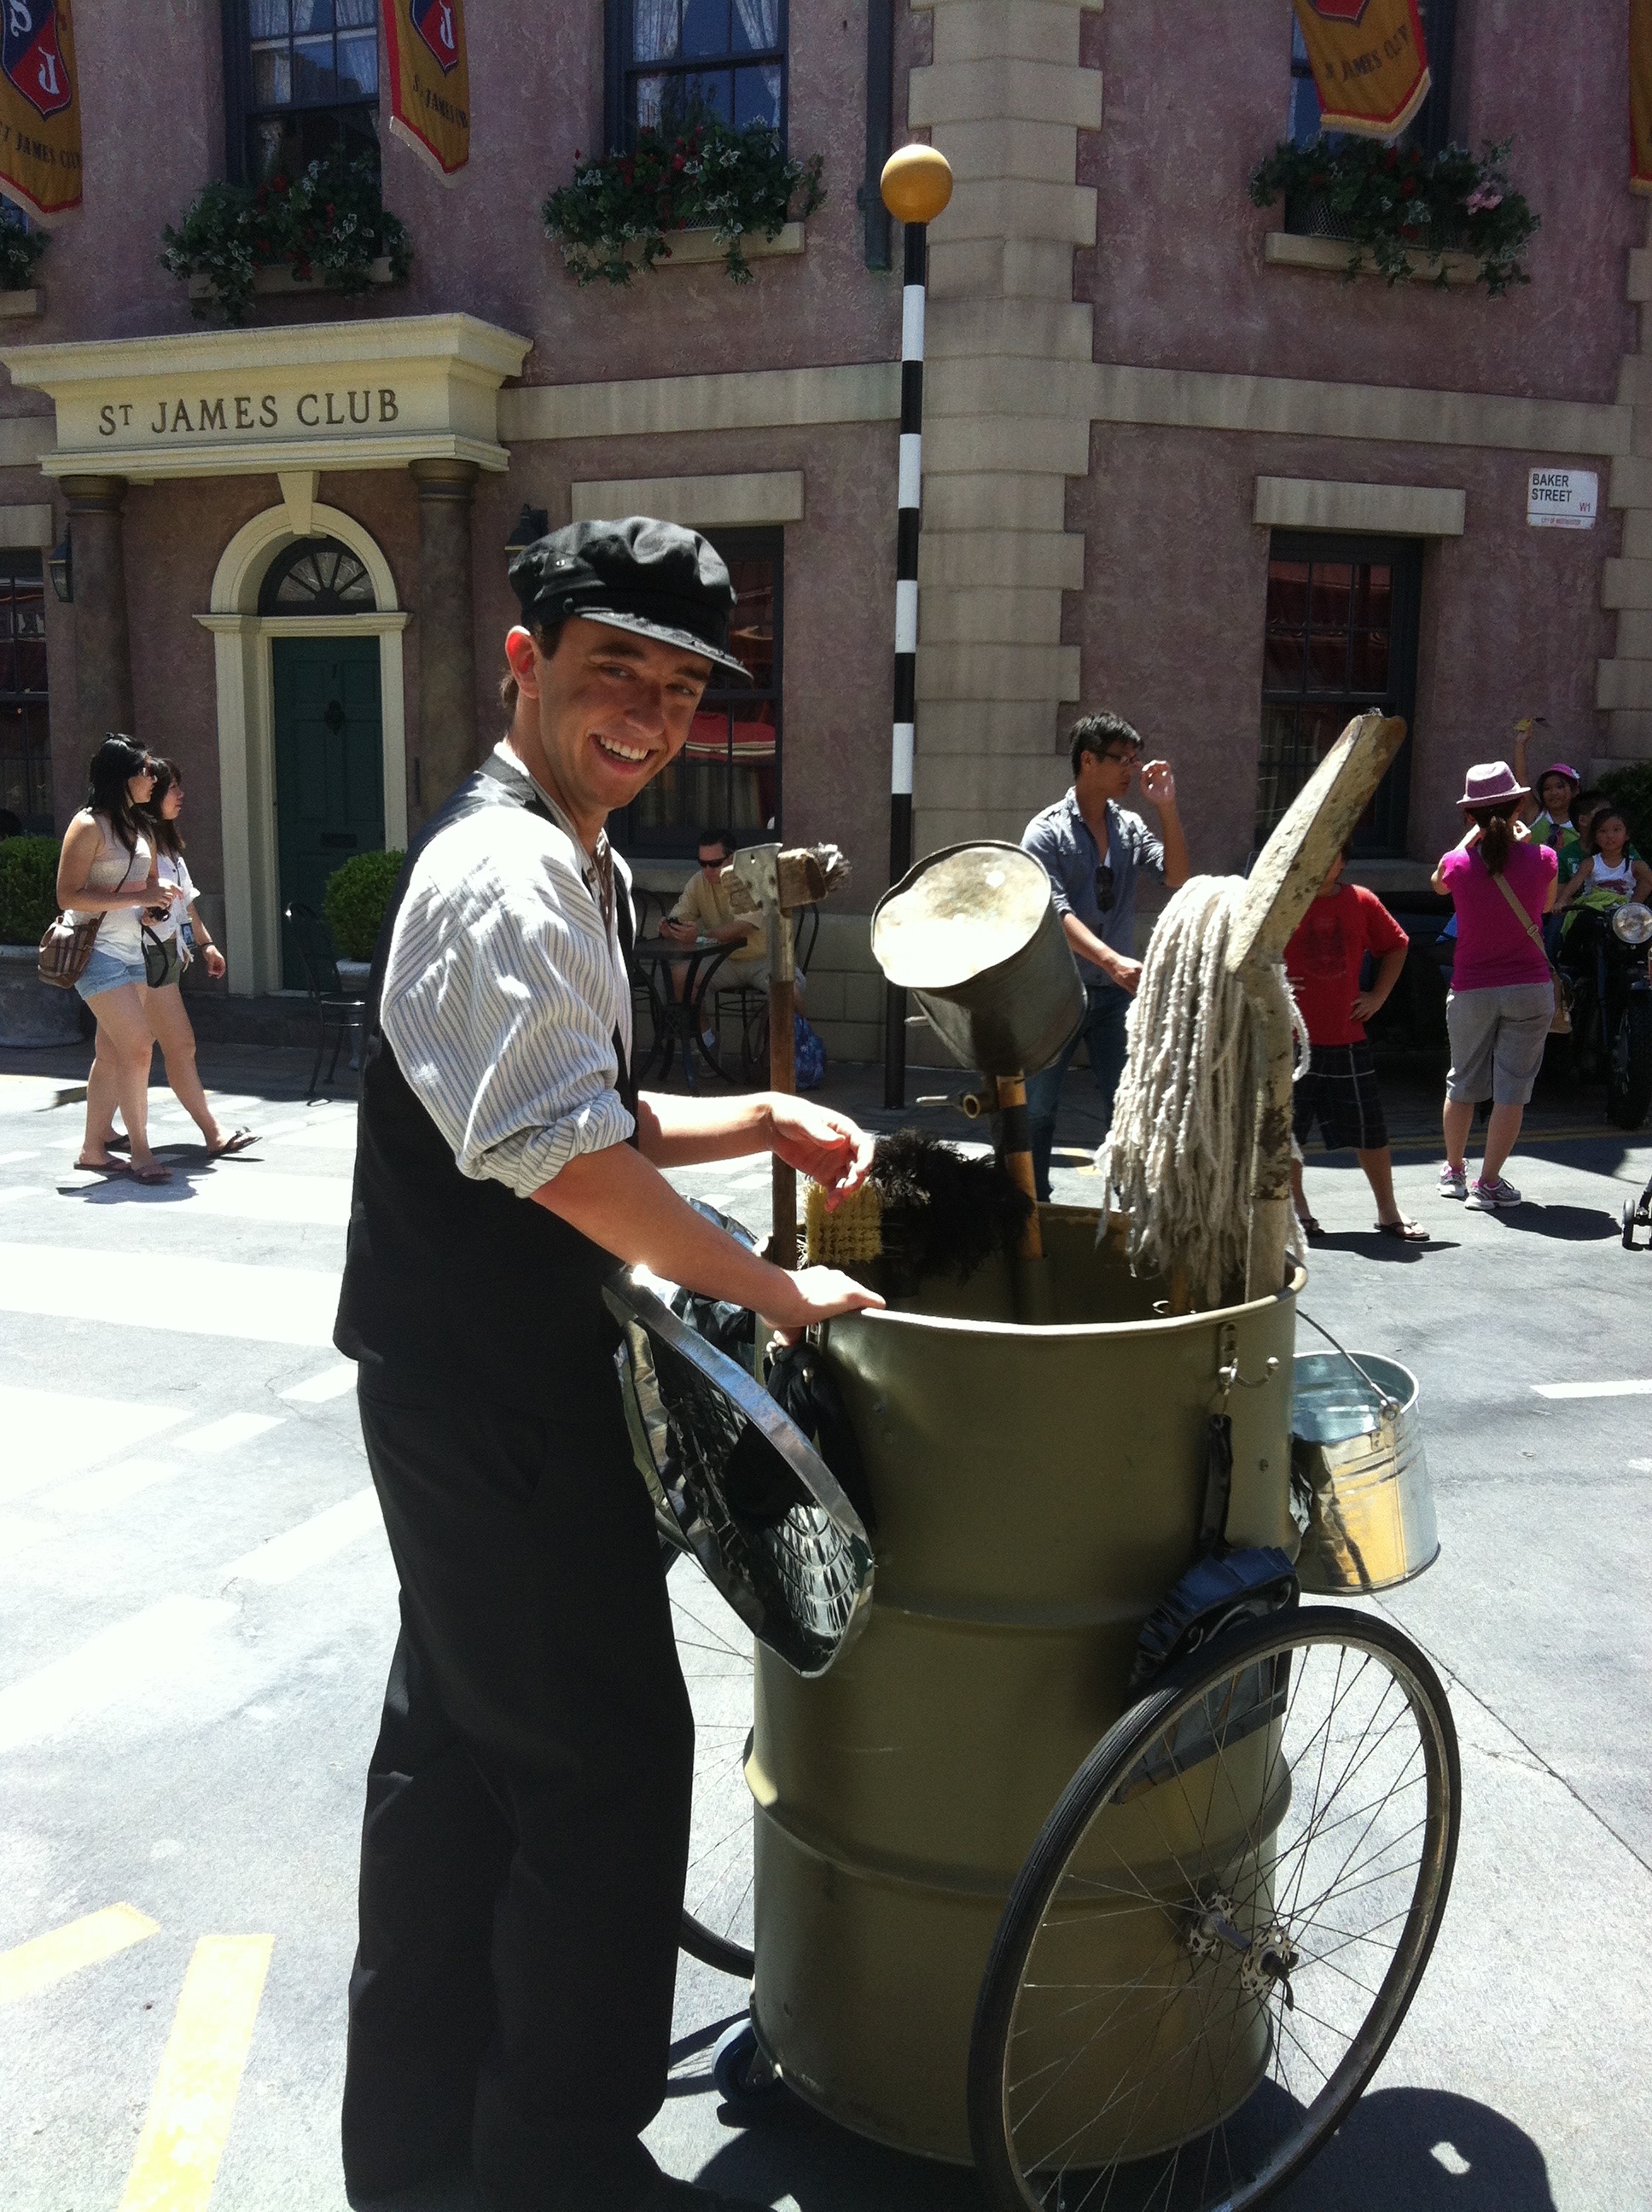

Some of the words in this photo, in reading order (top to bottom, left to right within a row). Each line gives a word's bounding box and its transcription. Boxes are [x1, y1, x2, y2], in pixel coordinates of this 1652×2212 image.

[99, 405, 133, 436] ST
[152, 395, 278, 434] JAMES
[297, 389, 399, 426] CLUB
[1533, 473, 1569, 487] BAKER
[1532, 488, 1573, 502] STREET
[1579, 502, 1591, 512] W1
